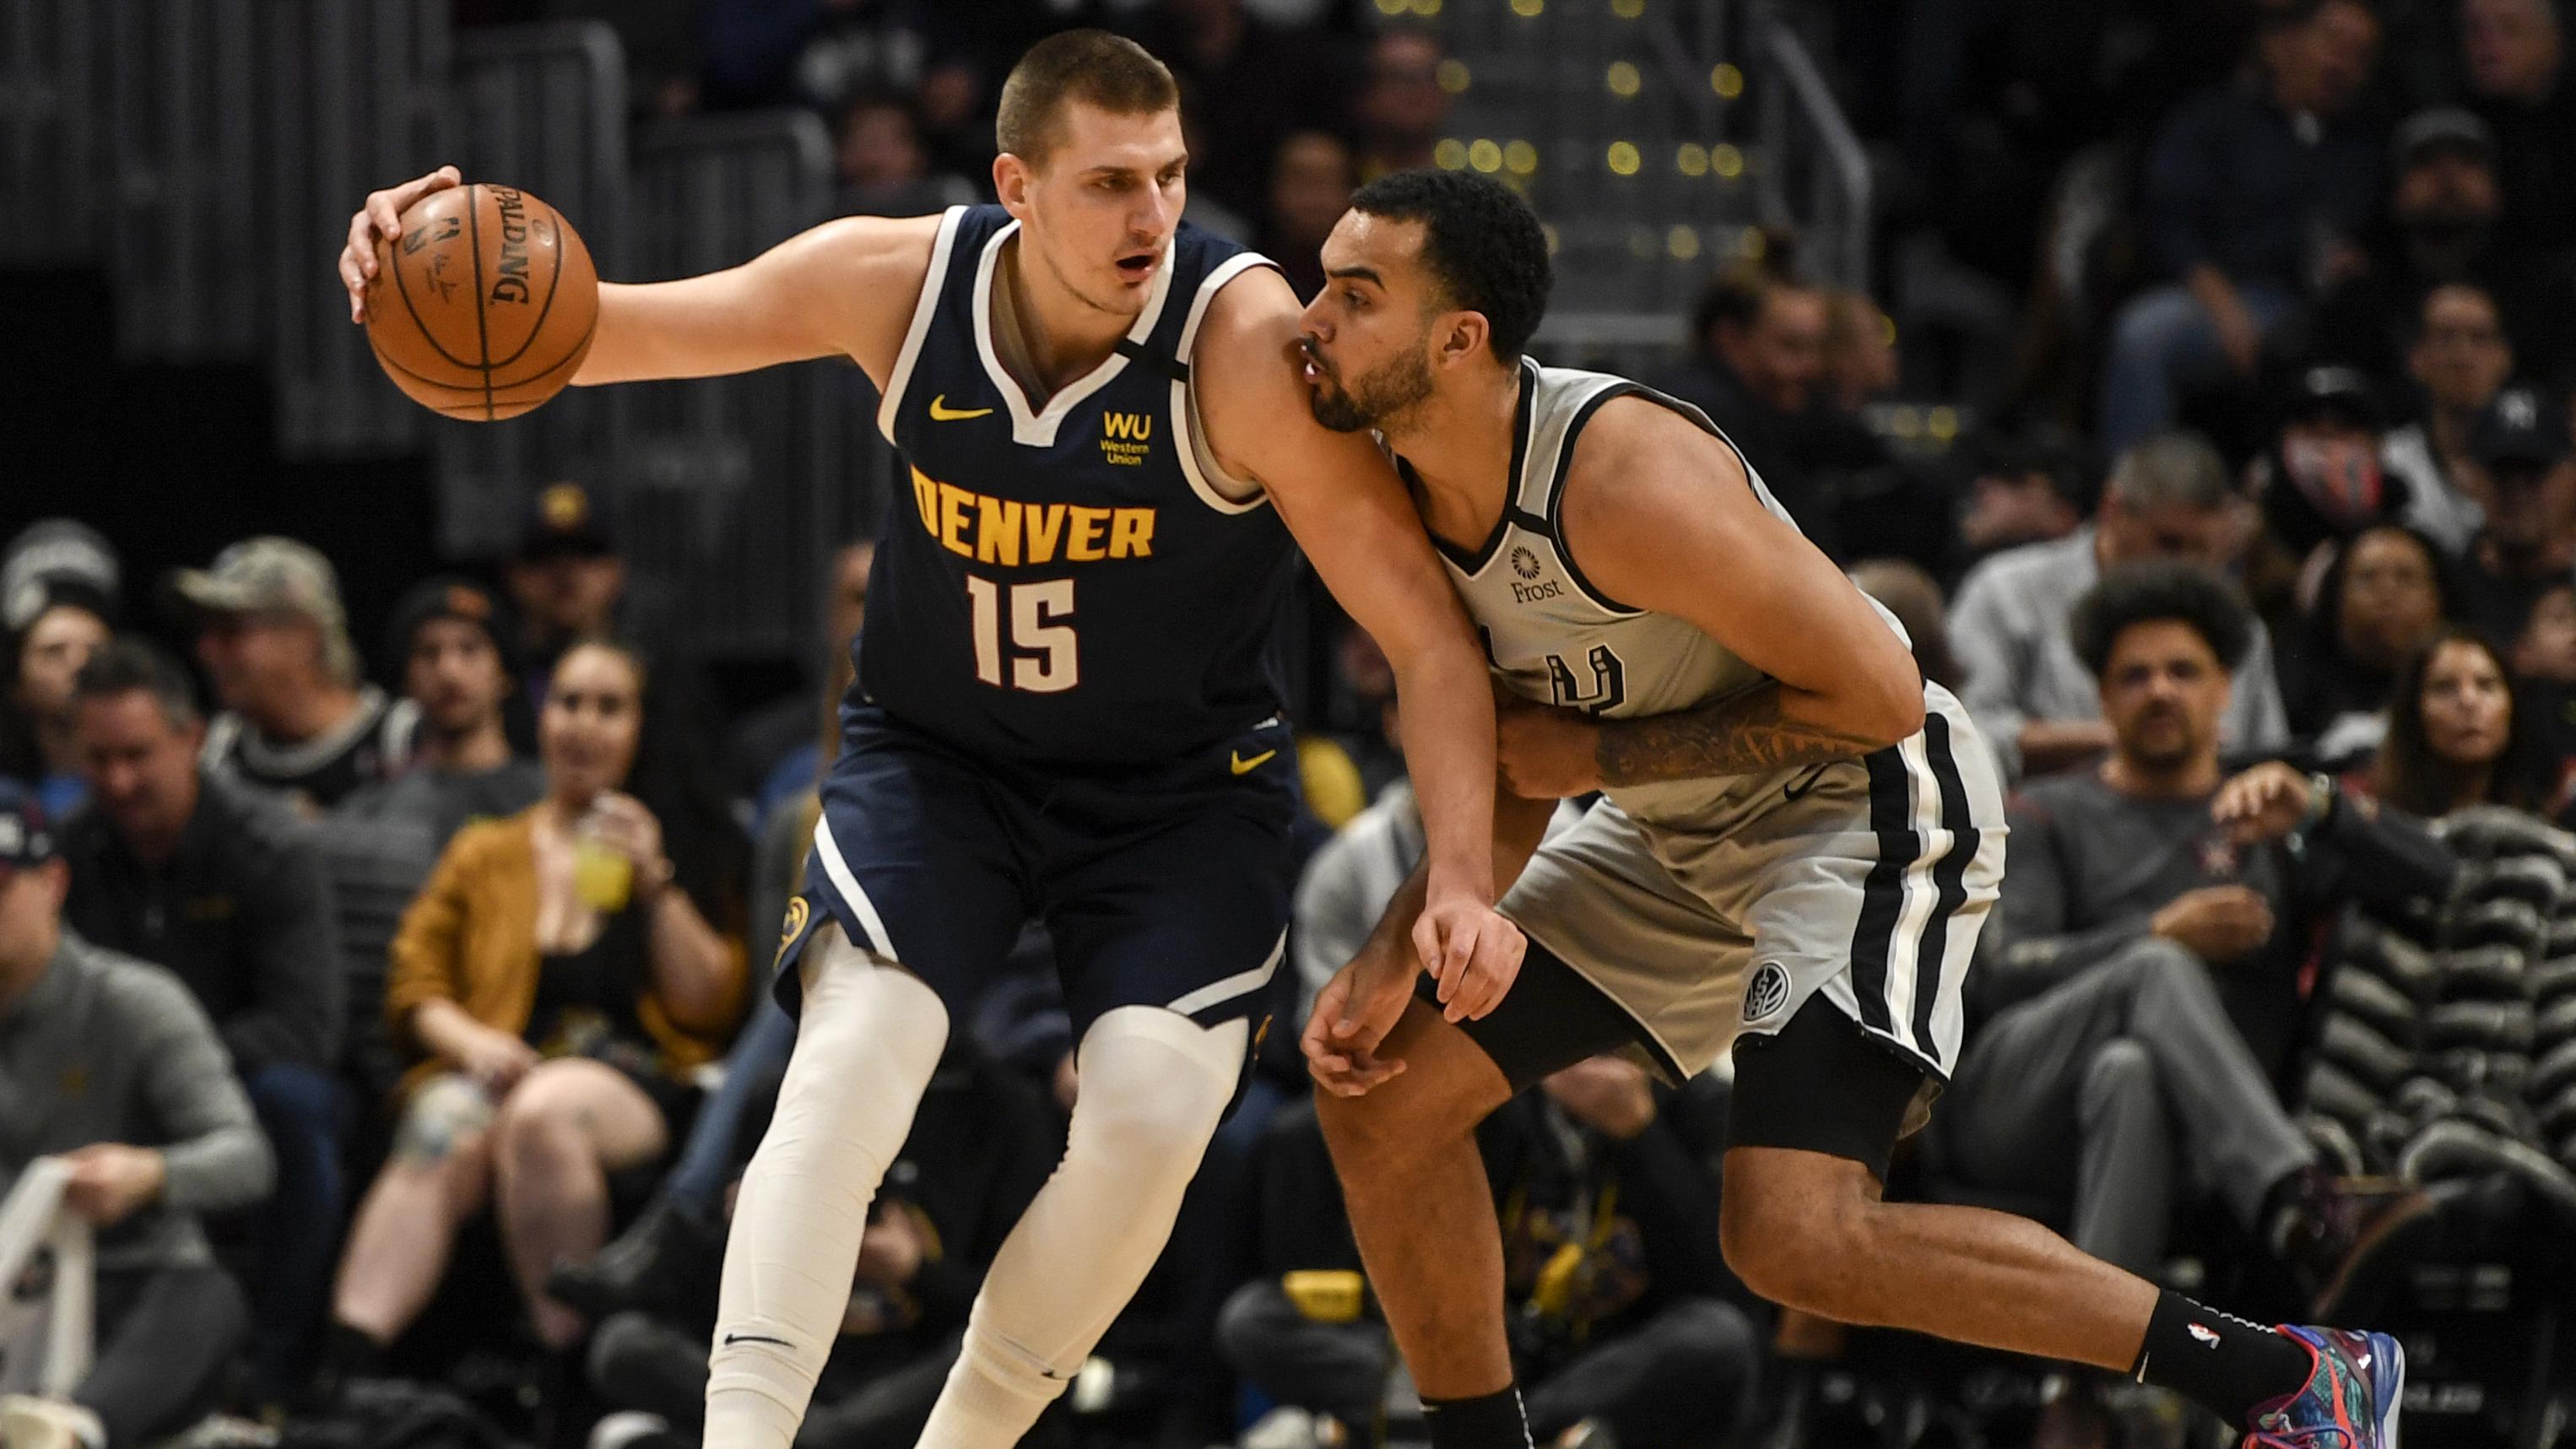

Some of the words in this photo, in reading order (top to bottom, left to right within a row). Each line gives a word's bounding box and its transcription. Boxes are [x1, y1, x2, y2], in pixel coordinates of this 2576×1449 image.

[1105, 412, 1151, 440] WU
[1101, 440, 1150, 454] Western
[1107, 453, 1142, 466] Union
[910, 463, 1156, 567] DENVER
[1511, 579, 1564, 603] Frost
[966, 573, 1080, 693] 15
